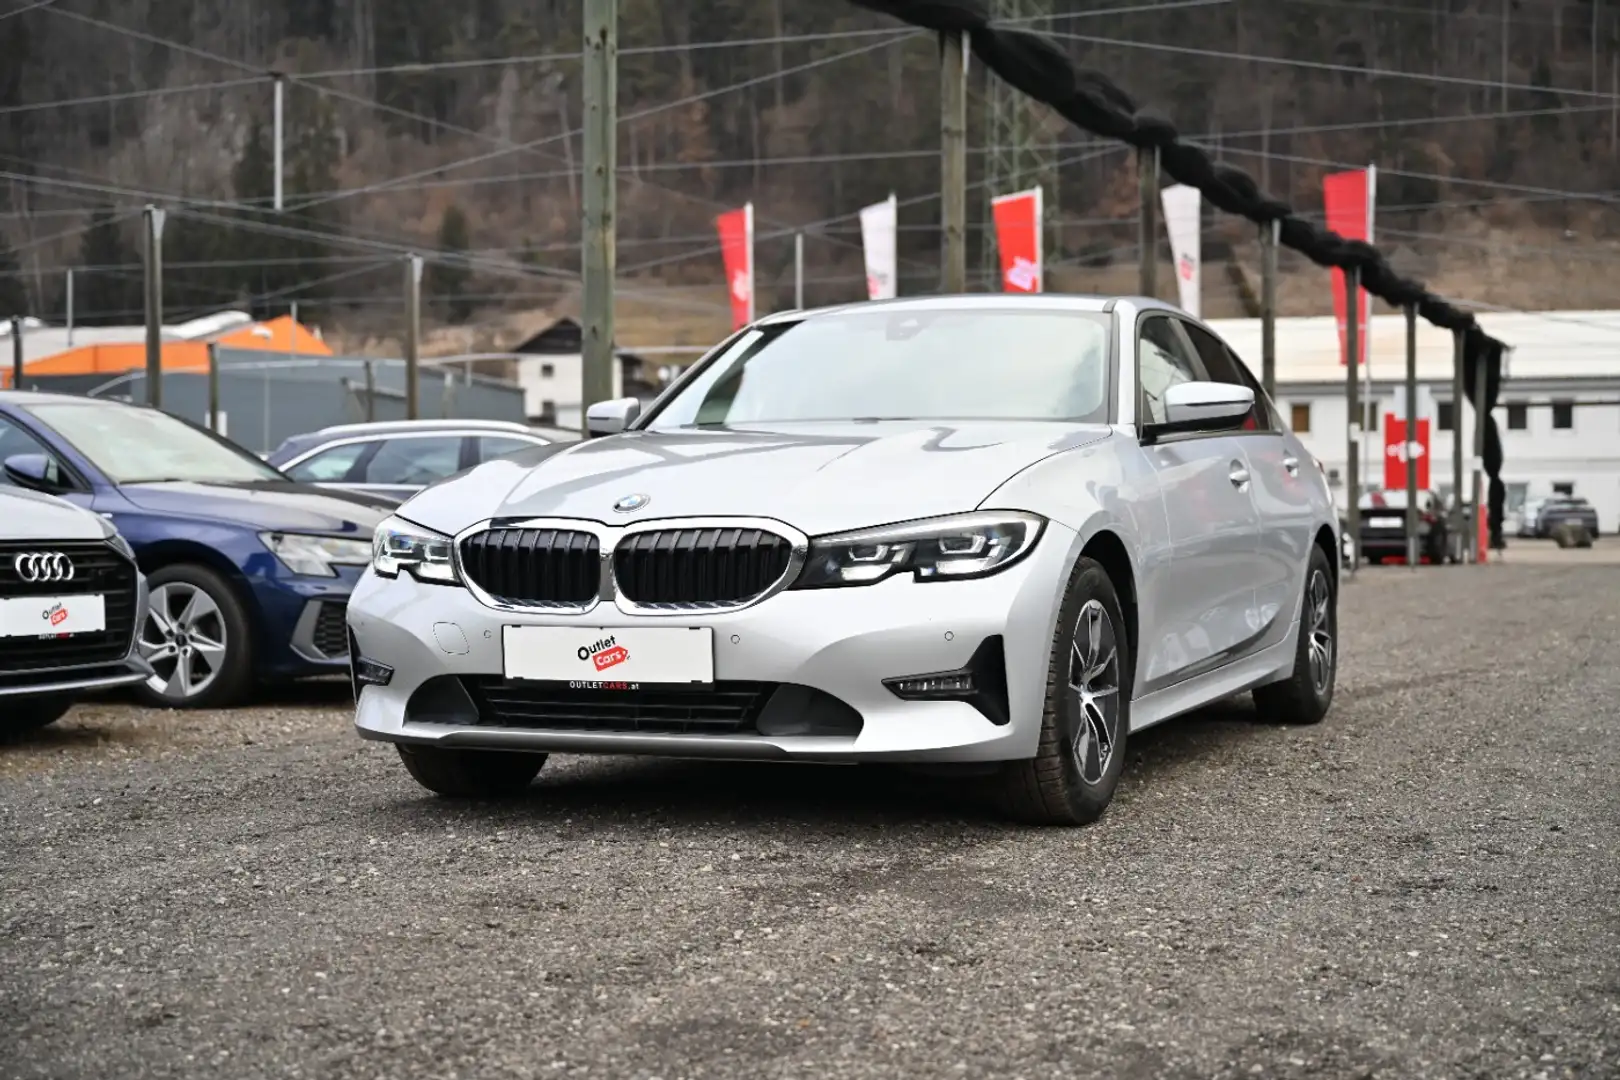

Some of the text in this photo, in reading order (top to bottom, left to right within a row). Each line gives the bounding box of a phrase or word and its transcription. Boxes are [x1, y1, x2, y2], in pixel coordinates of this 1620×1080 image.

[577, 635, 616, 661] Outlet
[596, 650, 622, 666] Cars
[569, 680, 640, 690] OUTLETCARS.at
